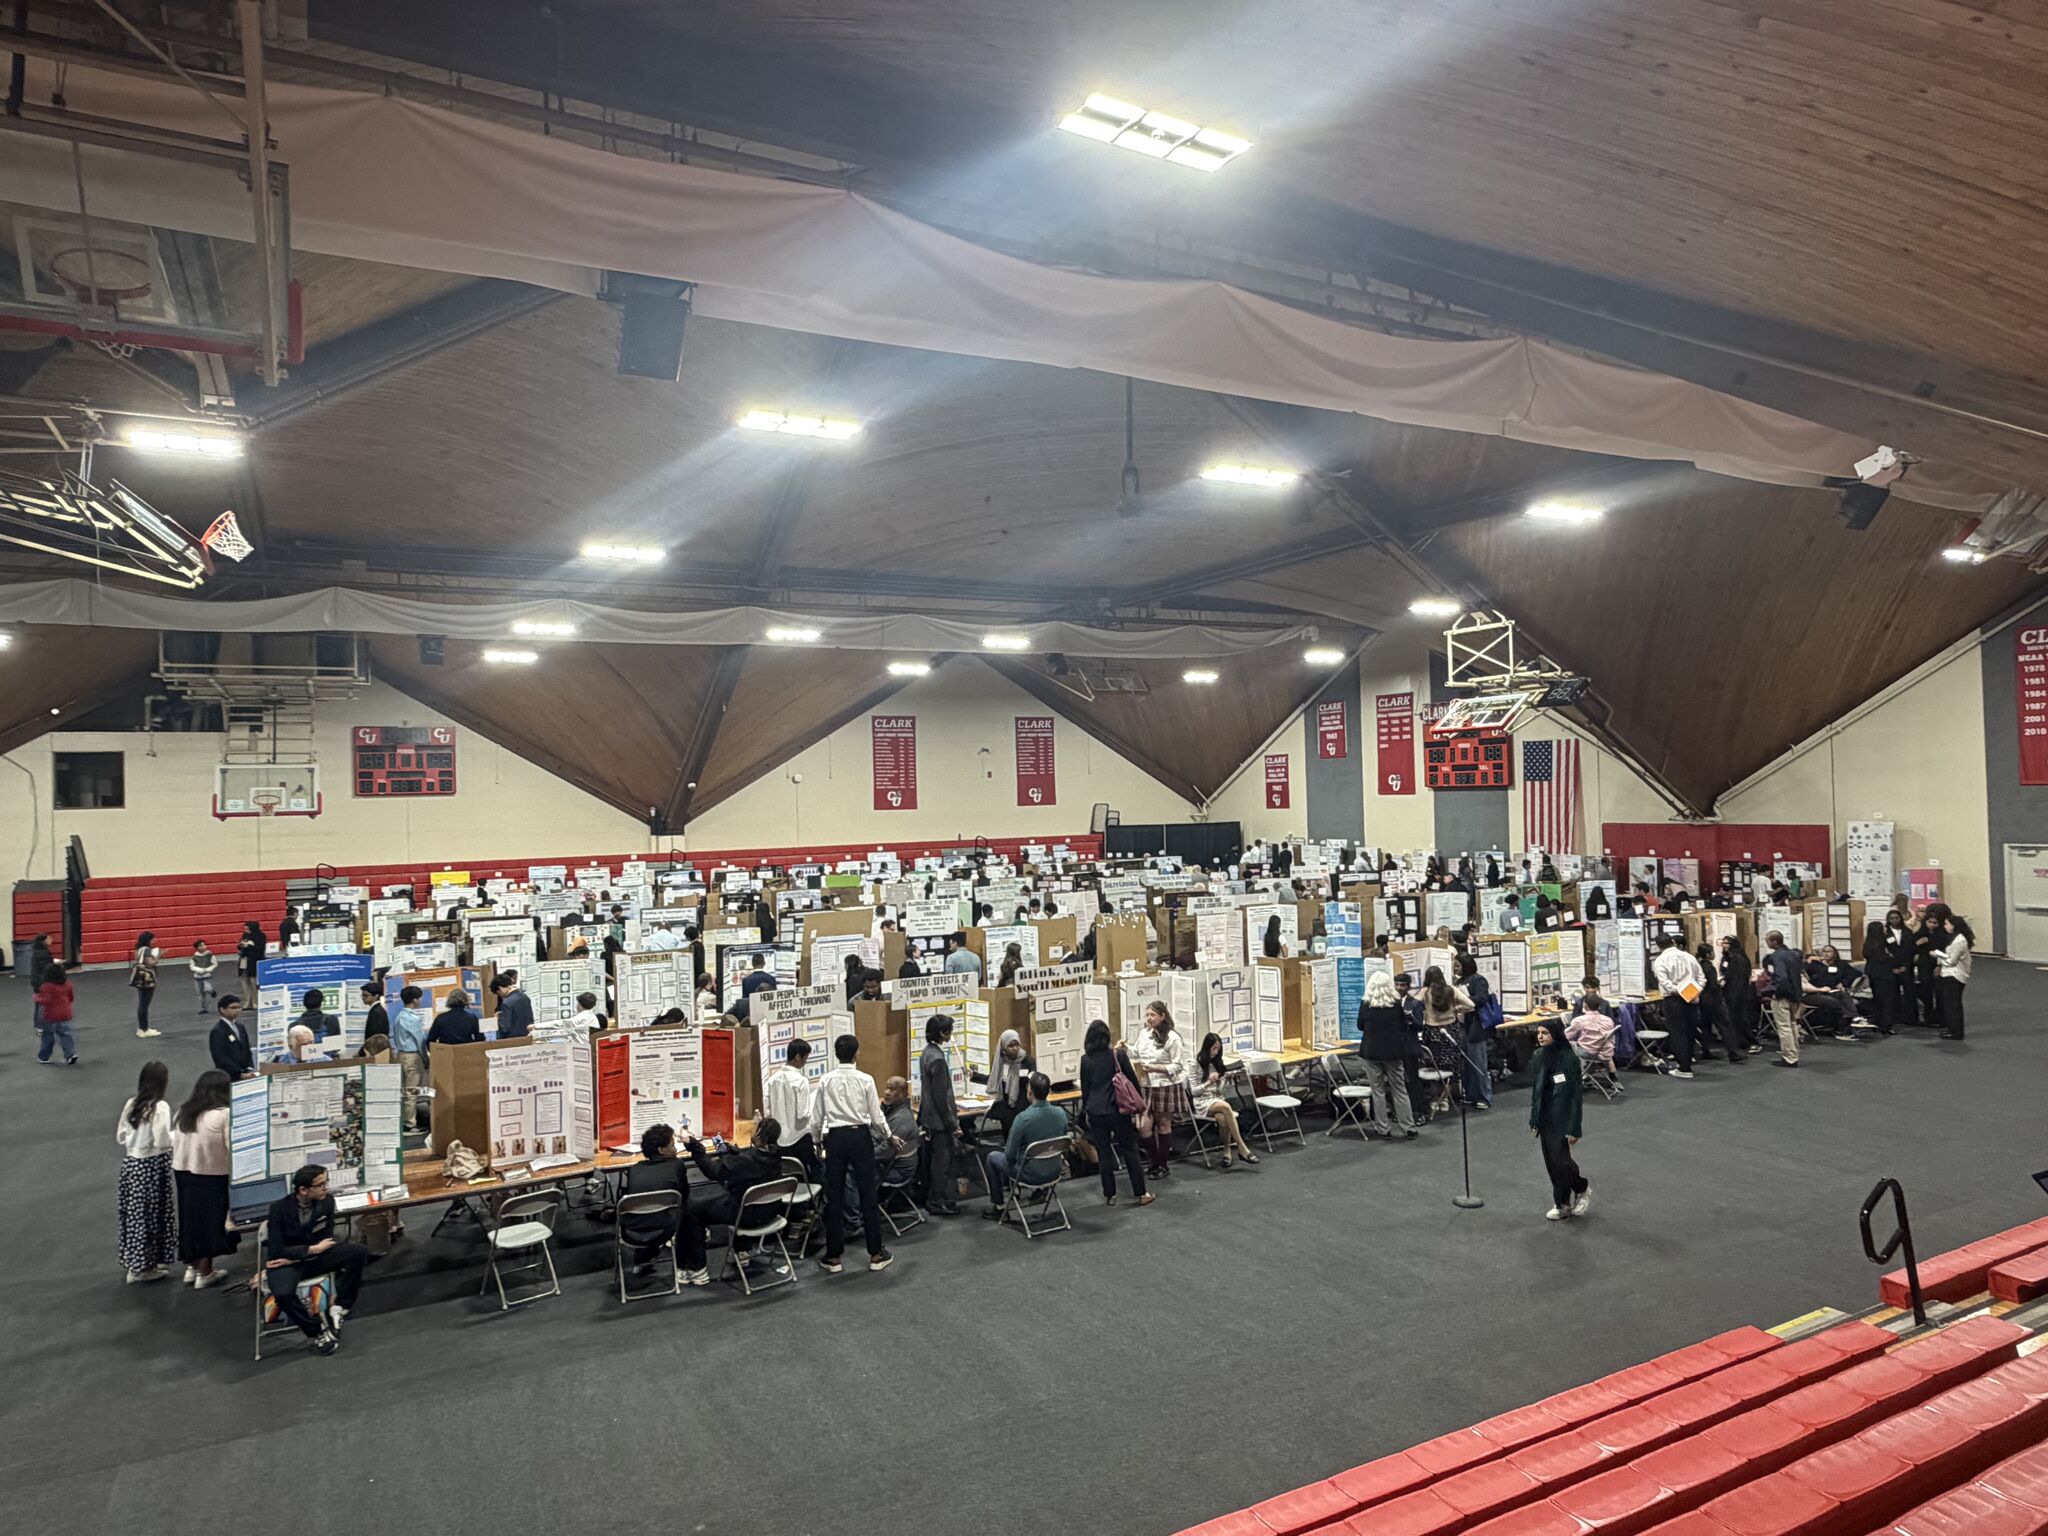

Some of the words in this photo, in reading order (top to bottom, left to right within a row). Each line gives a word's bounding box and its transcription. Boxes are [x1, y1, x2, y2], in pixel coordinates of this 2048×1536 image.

[2018, 654, 2044, 662] NCAA
[2024, 677, 2045, 686] 1981
[2025, 690, 2046, 698] 1984
[1319, 702, 1342, 711] CLARK
[1378, 696, 1410, 708] CLARK
[2025, 702, 2046, 711] 1987
[874, 719, 913, 728] CLARK
[1017, 720, 1052, 728] CLARK
[2024, 715, 2045, 723] 2001
[358, 728, 376, 744] CU
[433, 728, 451, 744] CU
[2024, 727, 2047, 736] 2010
[1265, 756, 1287, 764] CLARK
[1019, 967, 1060, 980] Blink,
[1064, 963, 1088, 976] And
[899, 977, 930, 989] COGNITIVE
[933, 974, 959, 986] EFFECTS
[962, 974, 969, 984] OF
[1016, 980, 1049, 993] You'll
[1051, 977, 1077, 989] Miss
[759, 991, 774, 1002] HOW
[813, 984, 836, 995] TRAITS
[909, 988, 928, 999] RAPID
[932, 985, 957, 996] STIMULI
[768, 998, 792, 1011] AFFECT
[799, 994, 831, 1007] THROWING
[777, 1007, 811, 1020] ACCURACY
